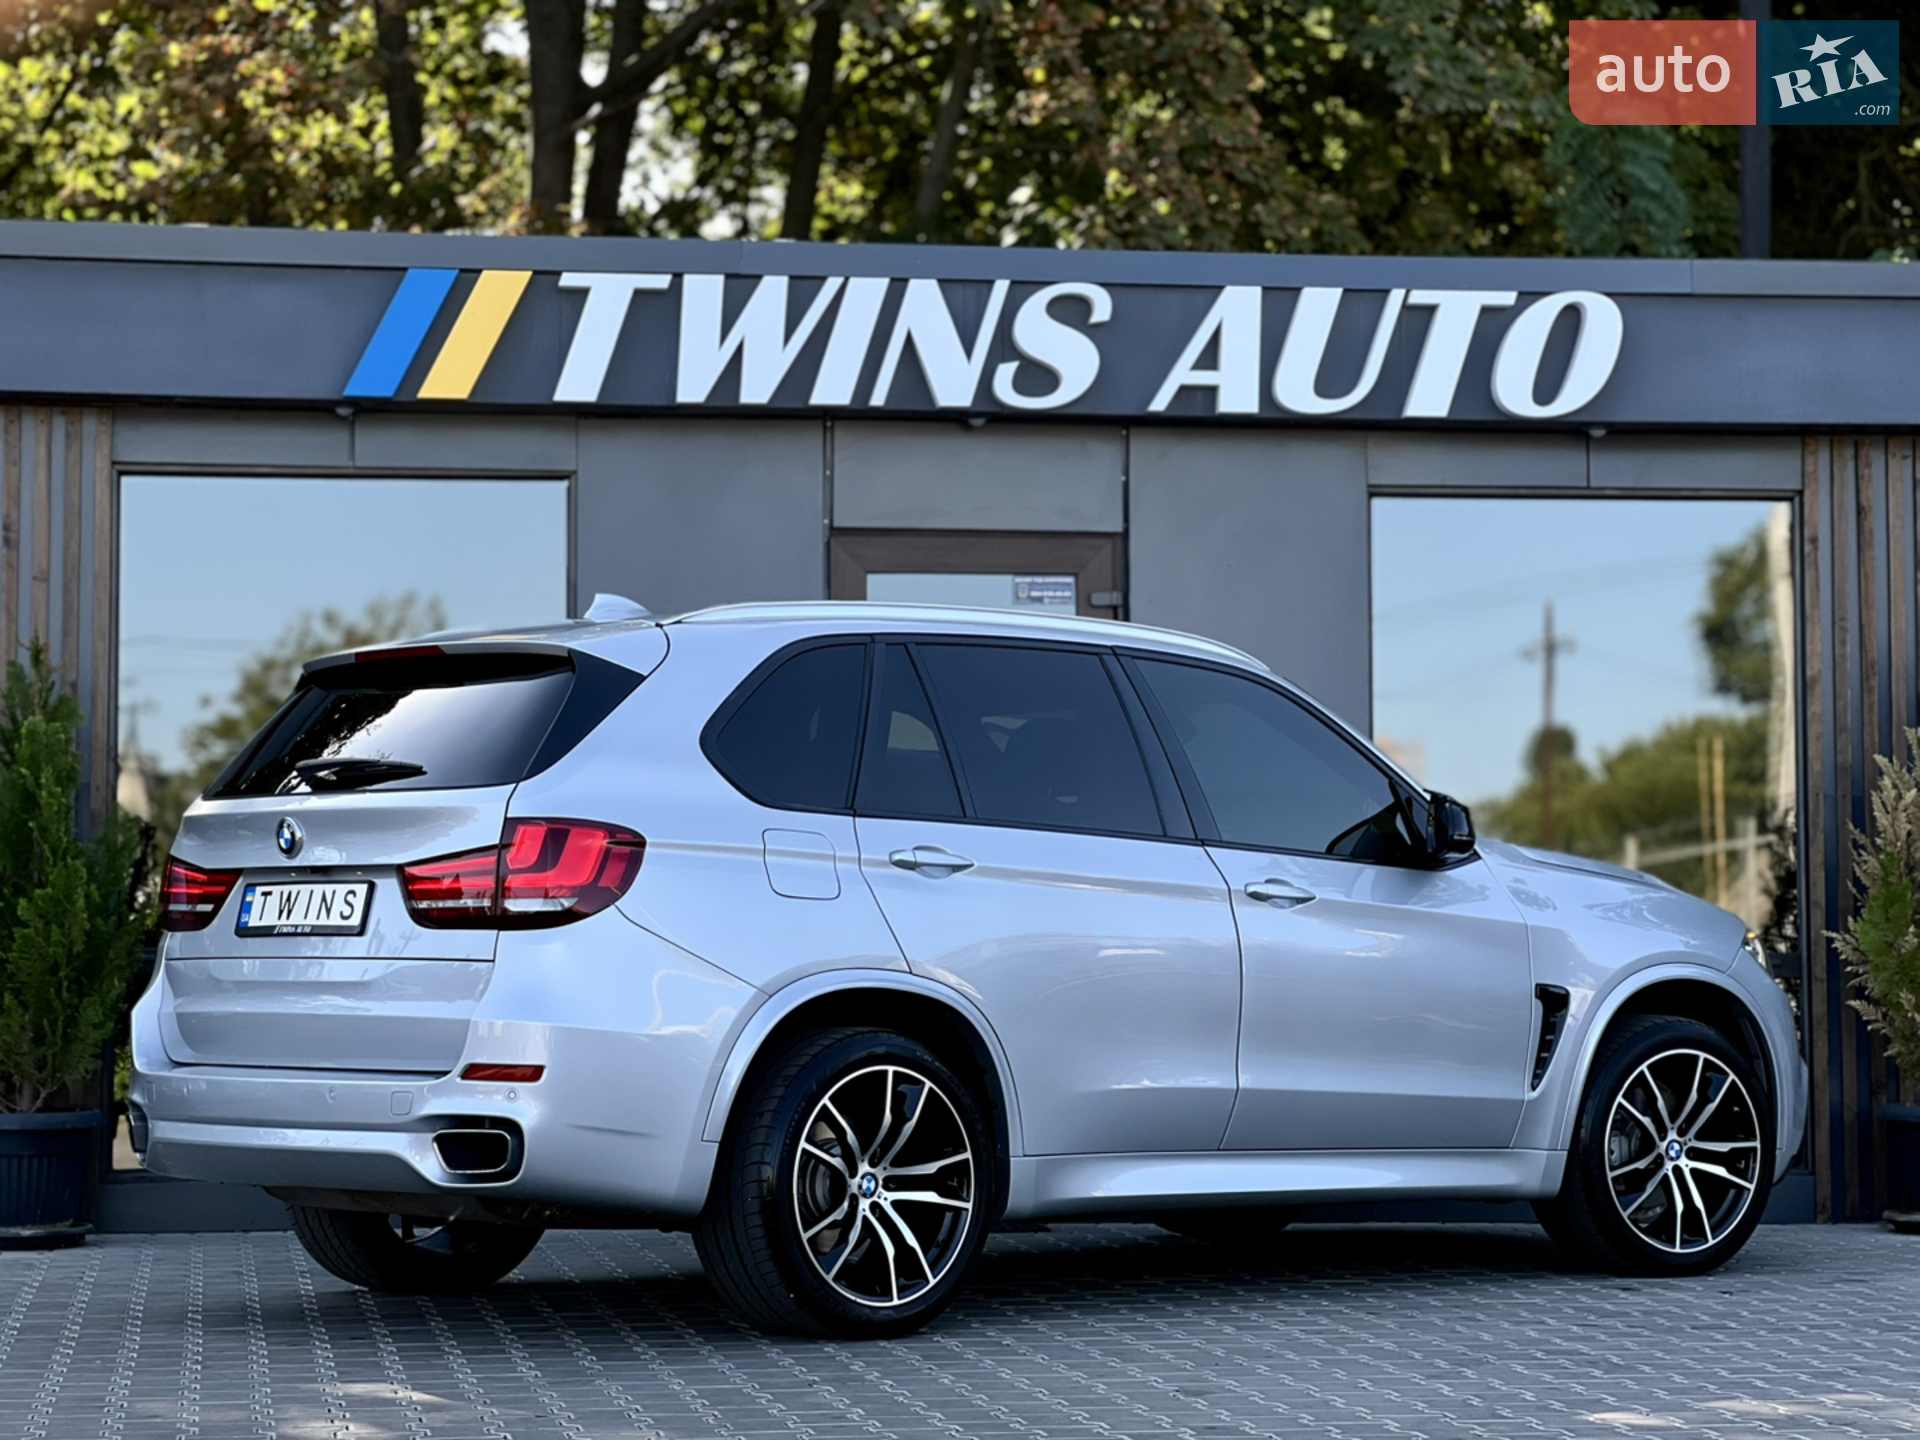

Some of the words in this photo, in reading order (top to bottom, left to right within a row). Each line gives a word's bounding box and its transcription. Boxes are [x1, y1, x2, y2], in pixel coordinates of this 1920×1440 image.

[552, 272, 1113, 410] TWINS
[1146, 285, 1625, 419] AUTO
[258, 889, 357, 922] TWINS
